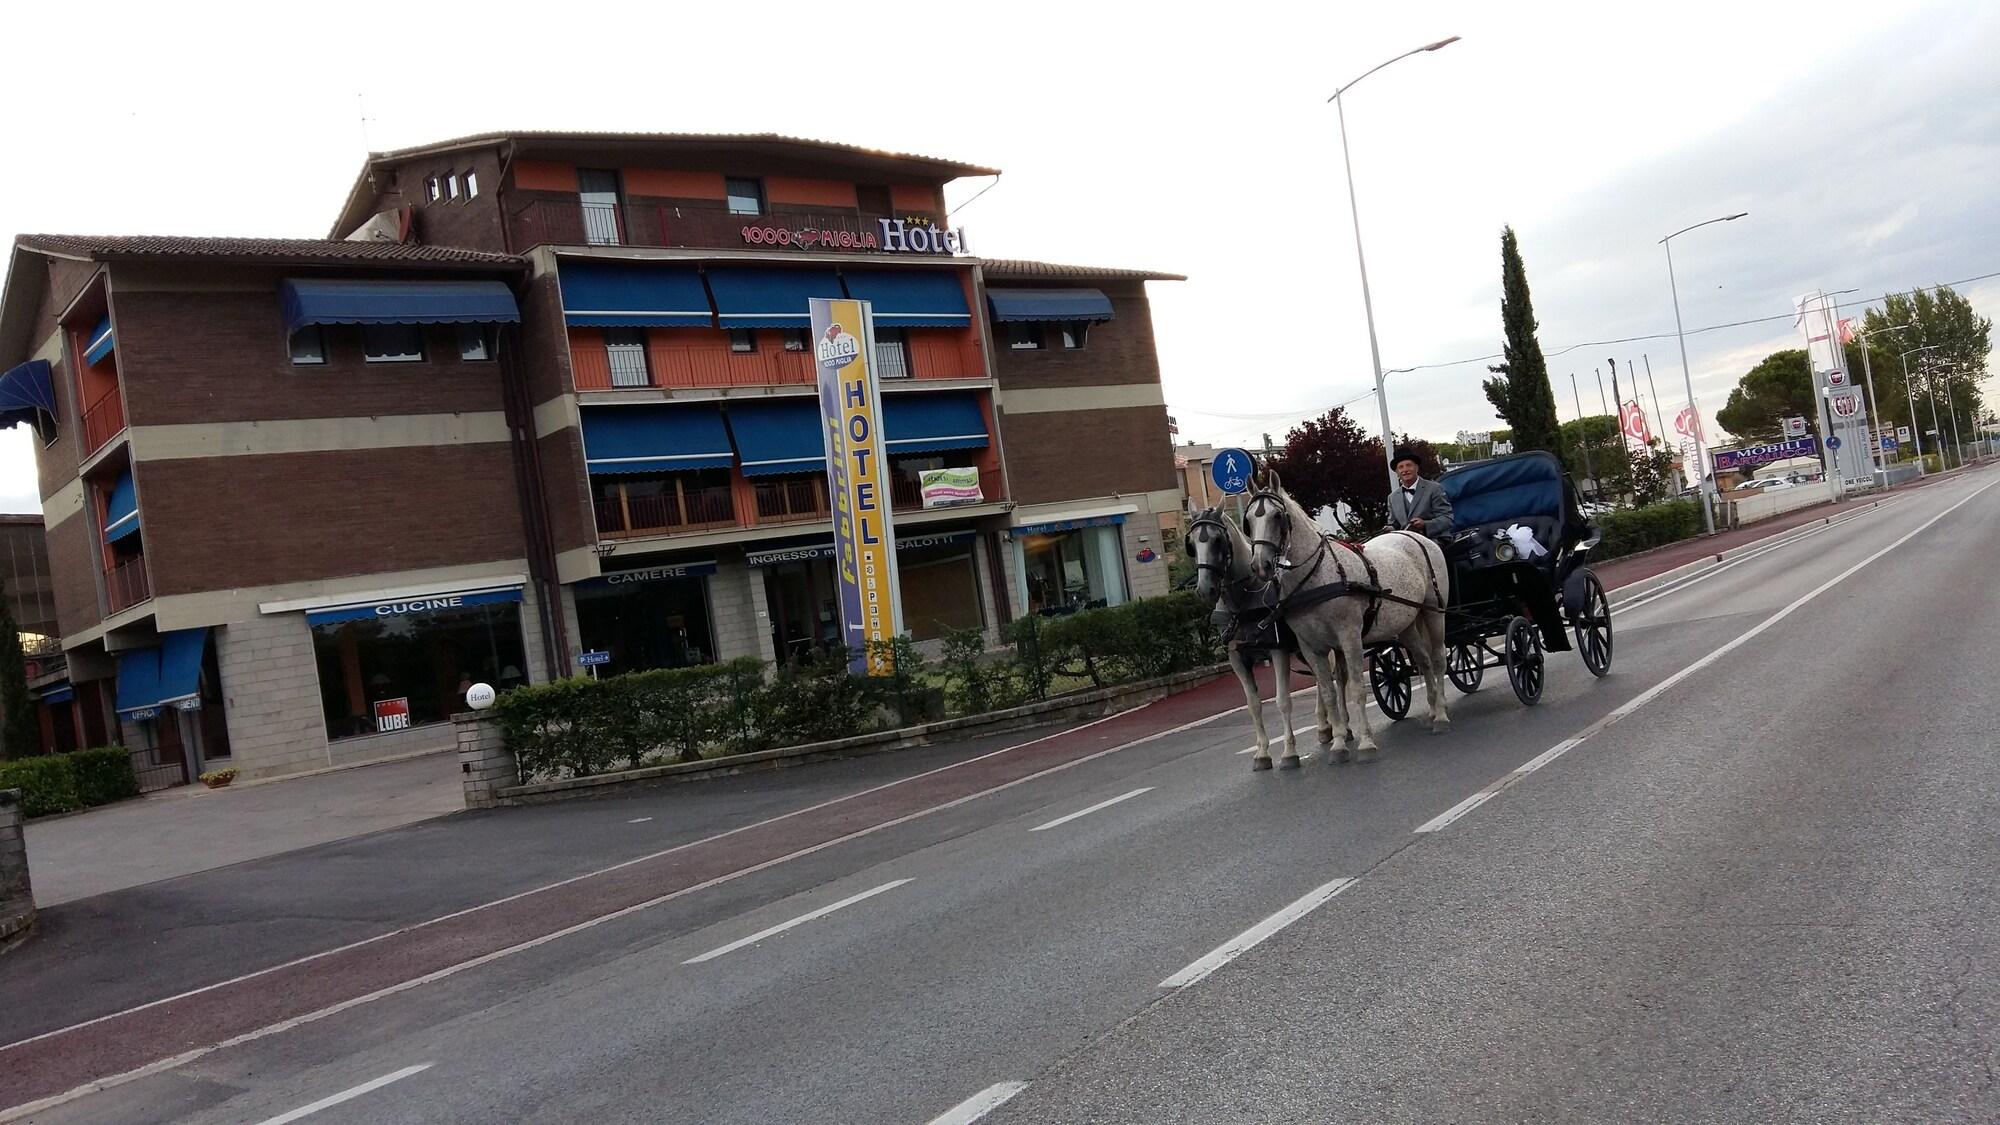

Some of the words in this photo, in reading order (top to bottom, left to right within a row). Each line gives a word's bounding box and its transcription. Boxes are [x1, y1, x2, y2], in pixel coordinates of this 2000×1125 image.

[741, 226, 792, 245] 1000
[821, 229, 877, 248] MIGLIA
[879, 218, 970, 254] Hotel
[820, 338, 856, 359] Hotel
[1718, 446, 1813, 469] BARTALUCCI
[1736, 441, 1801, 458] MOBILI
[845, 379, 879, 545] HOTEL
[895, 534, 954, 550] SALOTTI
[750, 549, 819, 565] INGRESSO
[607, 566, 688, 584] CAMERE
[375, 597, 463, 616] CUCINE
[471, 691, 492, 702] Hotel
[378, 712, 409, 732] LUBE
